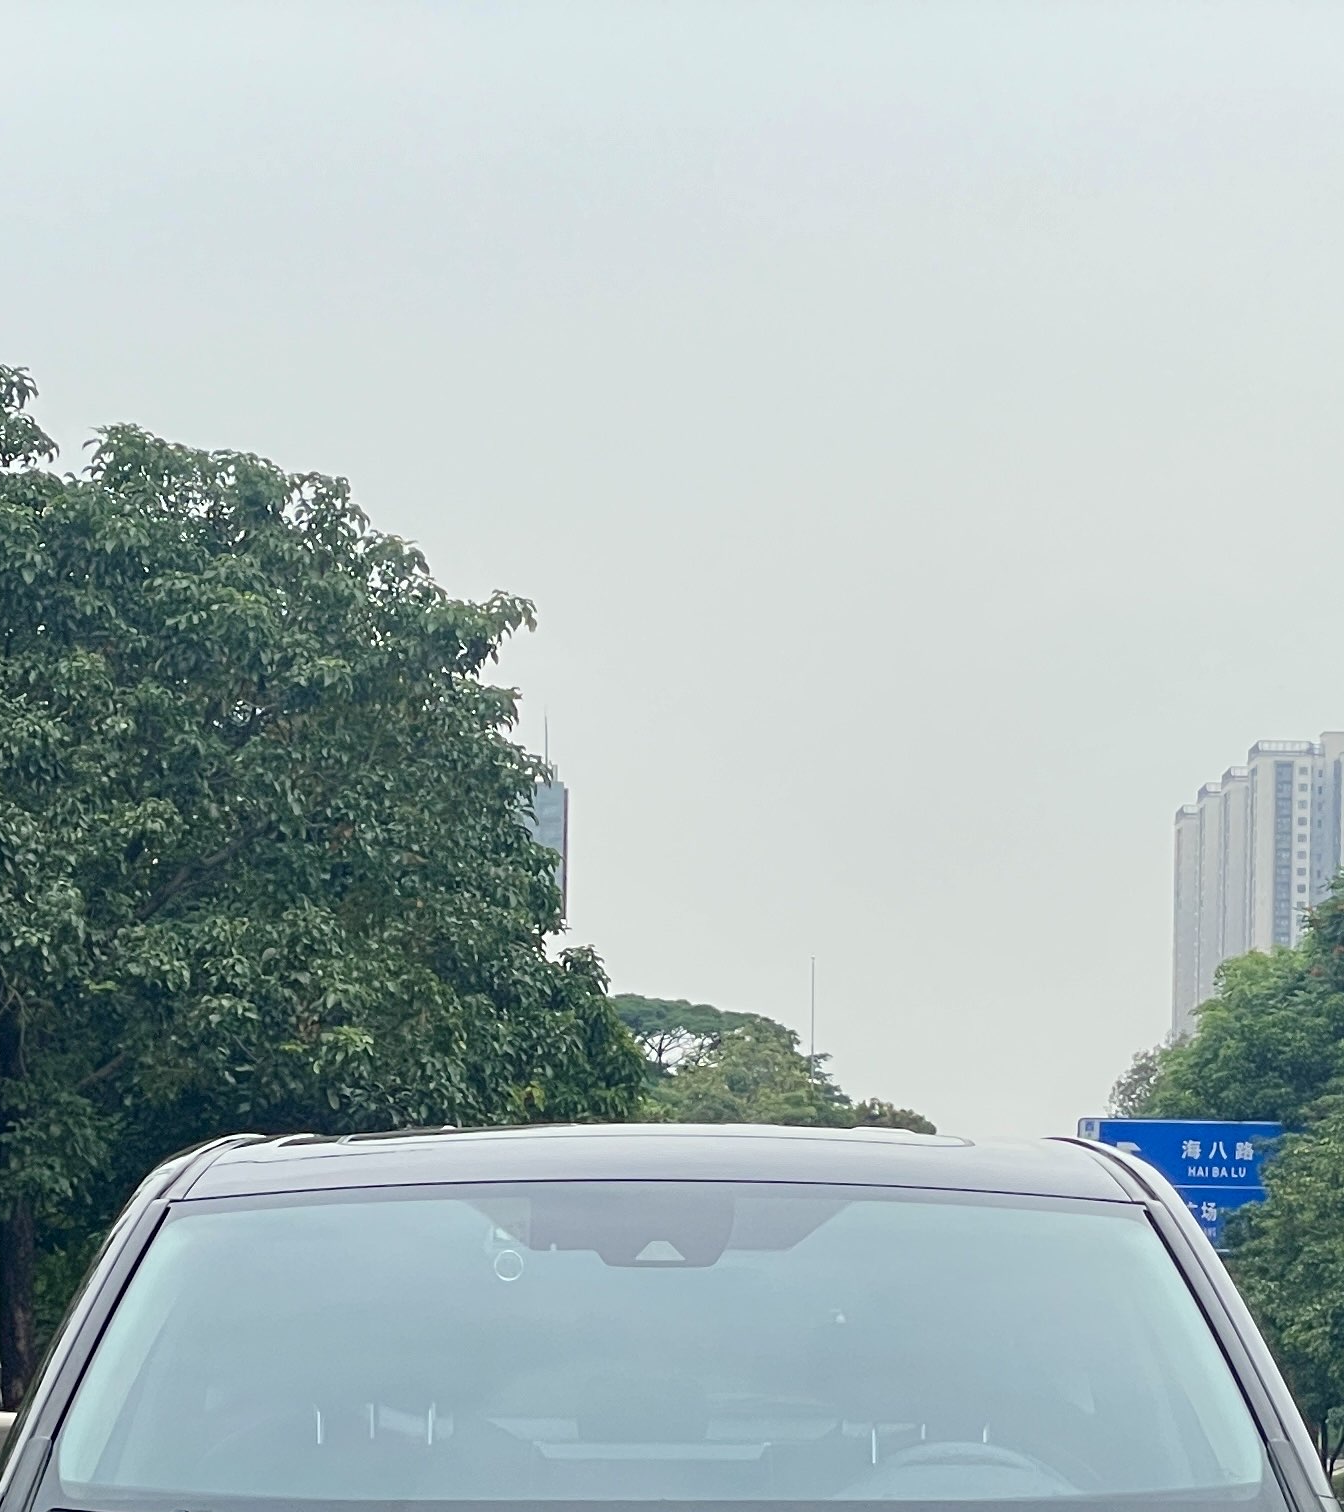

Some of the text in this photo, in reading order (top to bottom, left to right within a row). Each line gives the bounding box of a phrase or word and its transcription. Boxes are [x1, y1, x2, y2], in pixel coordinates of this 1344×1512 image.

[1181, 1139, 1254, 1160] 海八路
[1187, 1166, 1246, 1178] HAI BA LU
